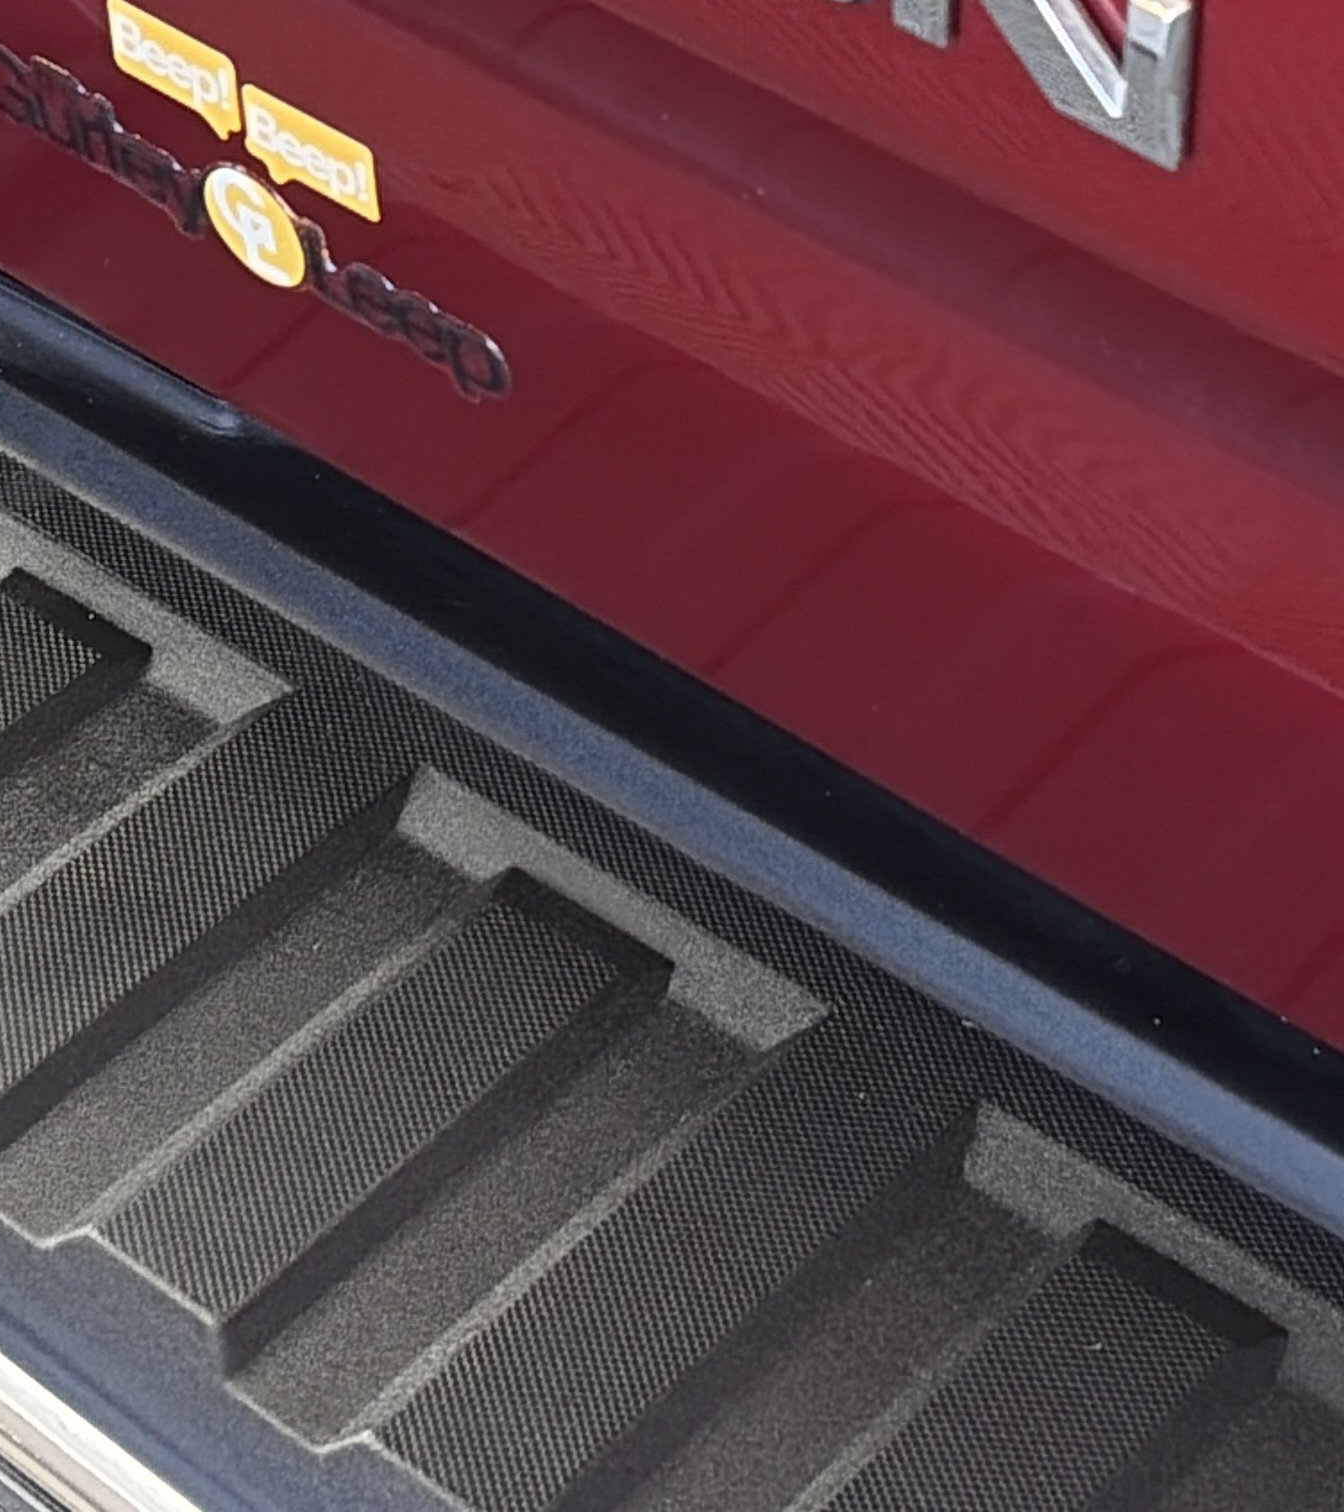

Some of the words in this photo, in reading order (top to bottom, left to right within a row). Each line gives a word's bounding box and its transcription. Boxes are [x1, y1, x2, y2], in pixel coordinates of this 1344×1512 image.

[115, 18, 233, 107] Beep!
[247, 107, 370, 201] Beep!
[295, 218, 510, 401] Leep
